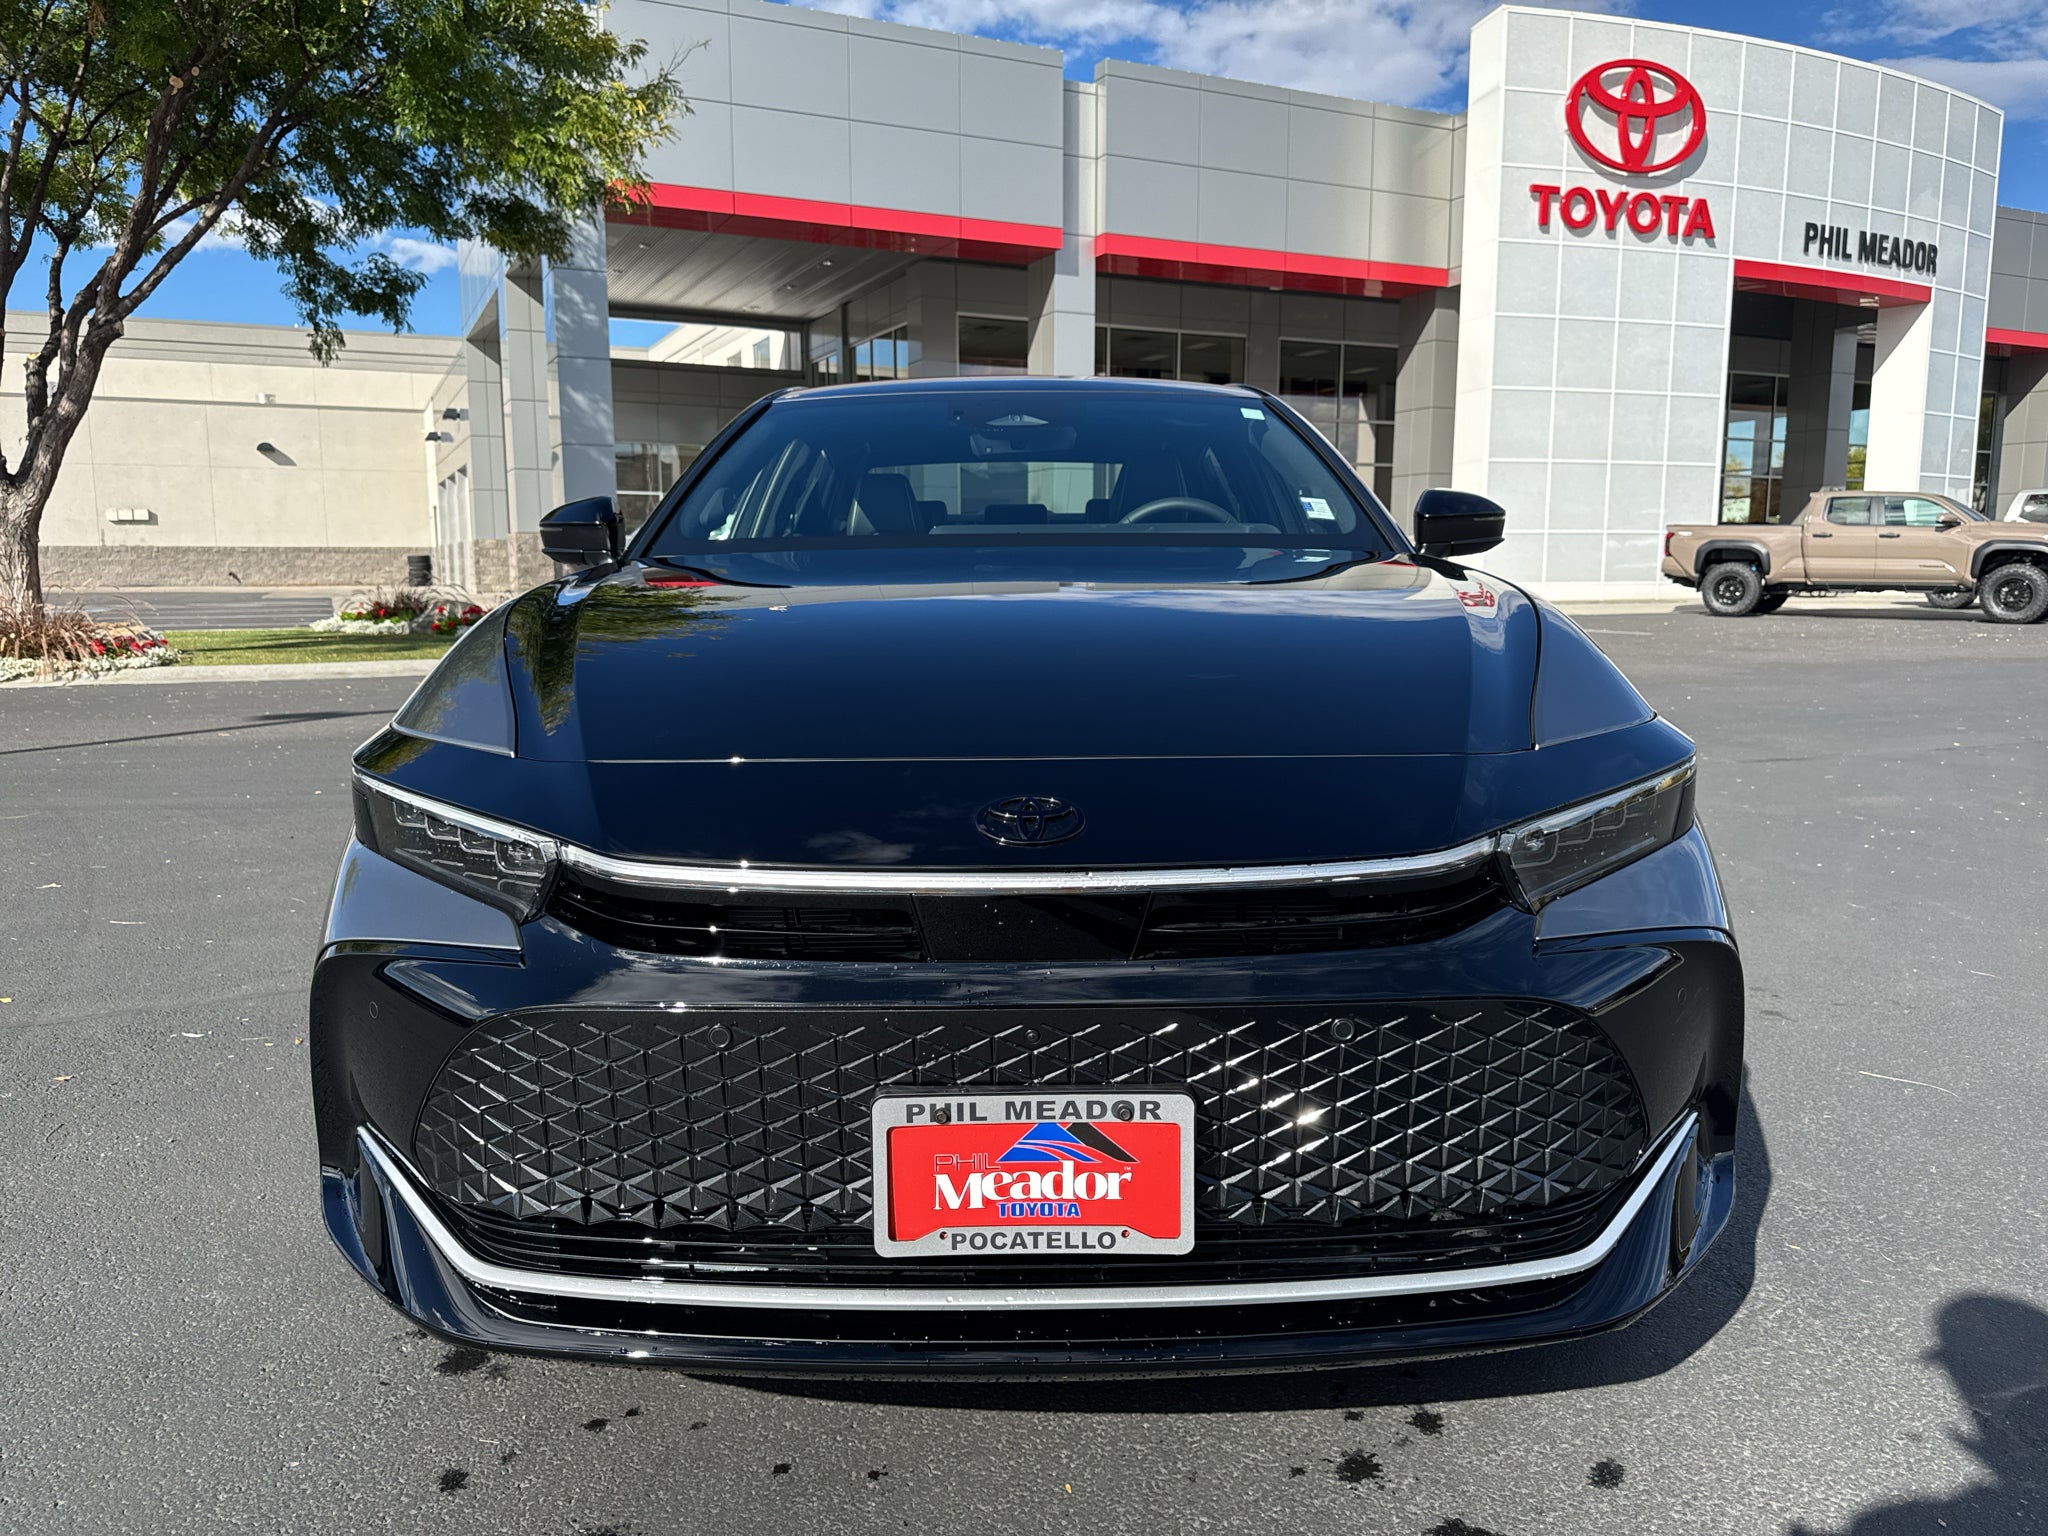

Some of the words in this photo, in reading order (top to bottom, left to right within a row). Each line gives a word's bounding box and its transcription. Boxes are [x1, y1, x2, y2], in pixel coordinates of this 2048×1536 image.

[1530, 184, 1715, 239] TOYOTA
[1804, 222, 1852, 260] PHIL
[1858, 230, 1938, 274] MEADOR
[906, 1102, 988, 1123] PHIL
[1005, 1100, 1162, 1120] MEADOR
[934, 1153, 1001, 1172] PHIL
[933, 1160, 1132, 1210] Meador
[996, 1202, 1081, 1218] TOYOTA
[951, 1231, 1117, 1250] POCATELLO
